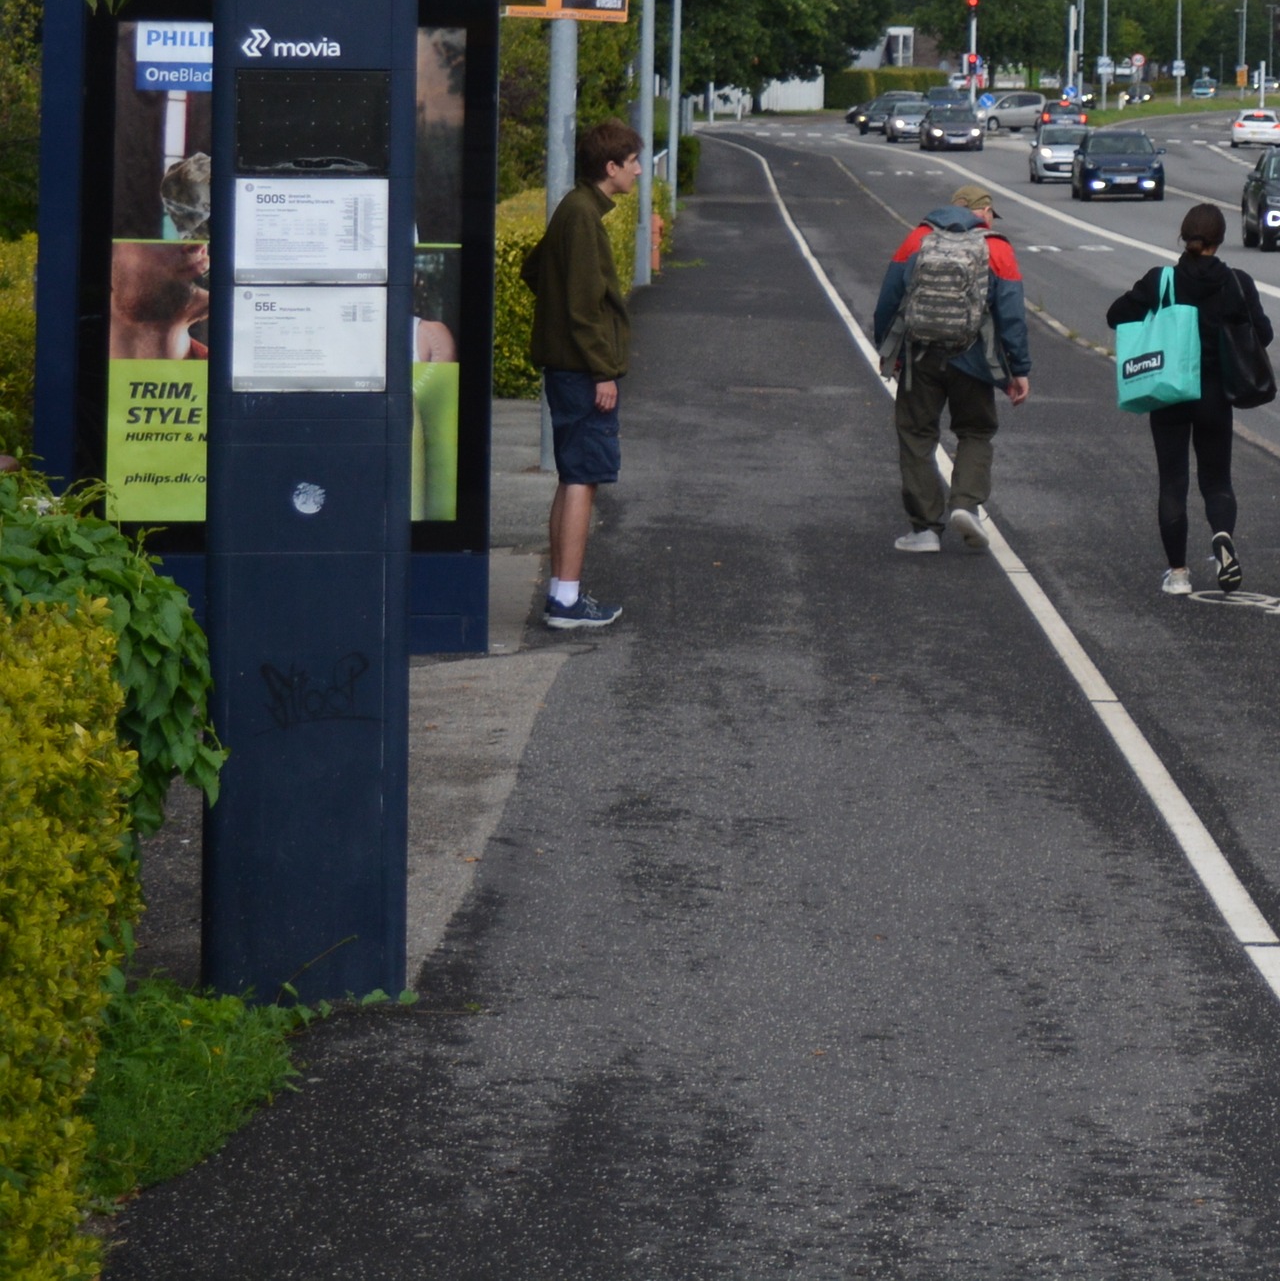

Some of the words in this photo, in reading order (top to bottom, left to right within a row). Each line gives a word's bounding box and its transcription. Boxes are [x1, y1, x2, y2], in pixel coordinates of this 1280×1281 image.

[146, 29, 213, 48] PHILI
[273, 37, 341, 57] movia
[256, 194, 286, 204] 500S
[255, 302, 277, 312] 55E
[1126, 354, 1162, 375] Normal
[129, 382, 198, 402] TRIM,
[126, 407, 203, 425] STYLE
[125, 432, 182, 442] HURTIGT
[184, 432, 194, 442] &
